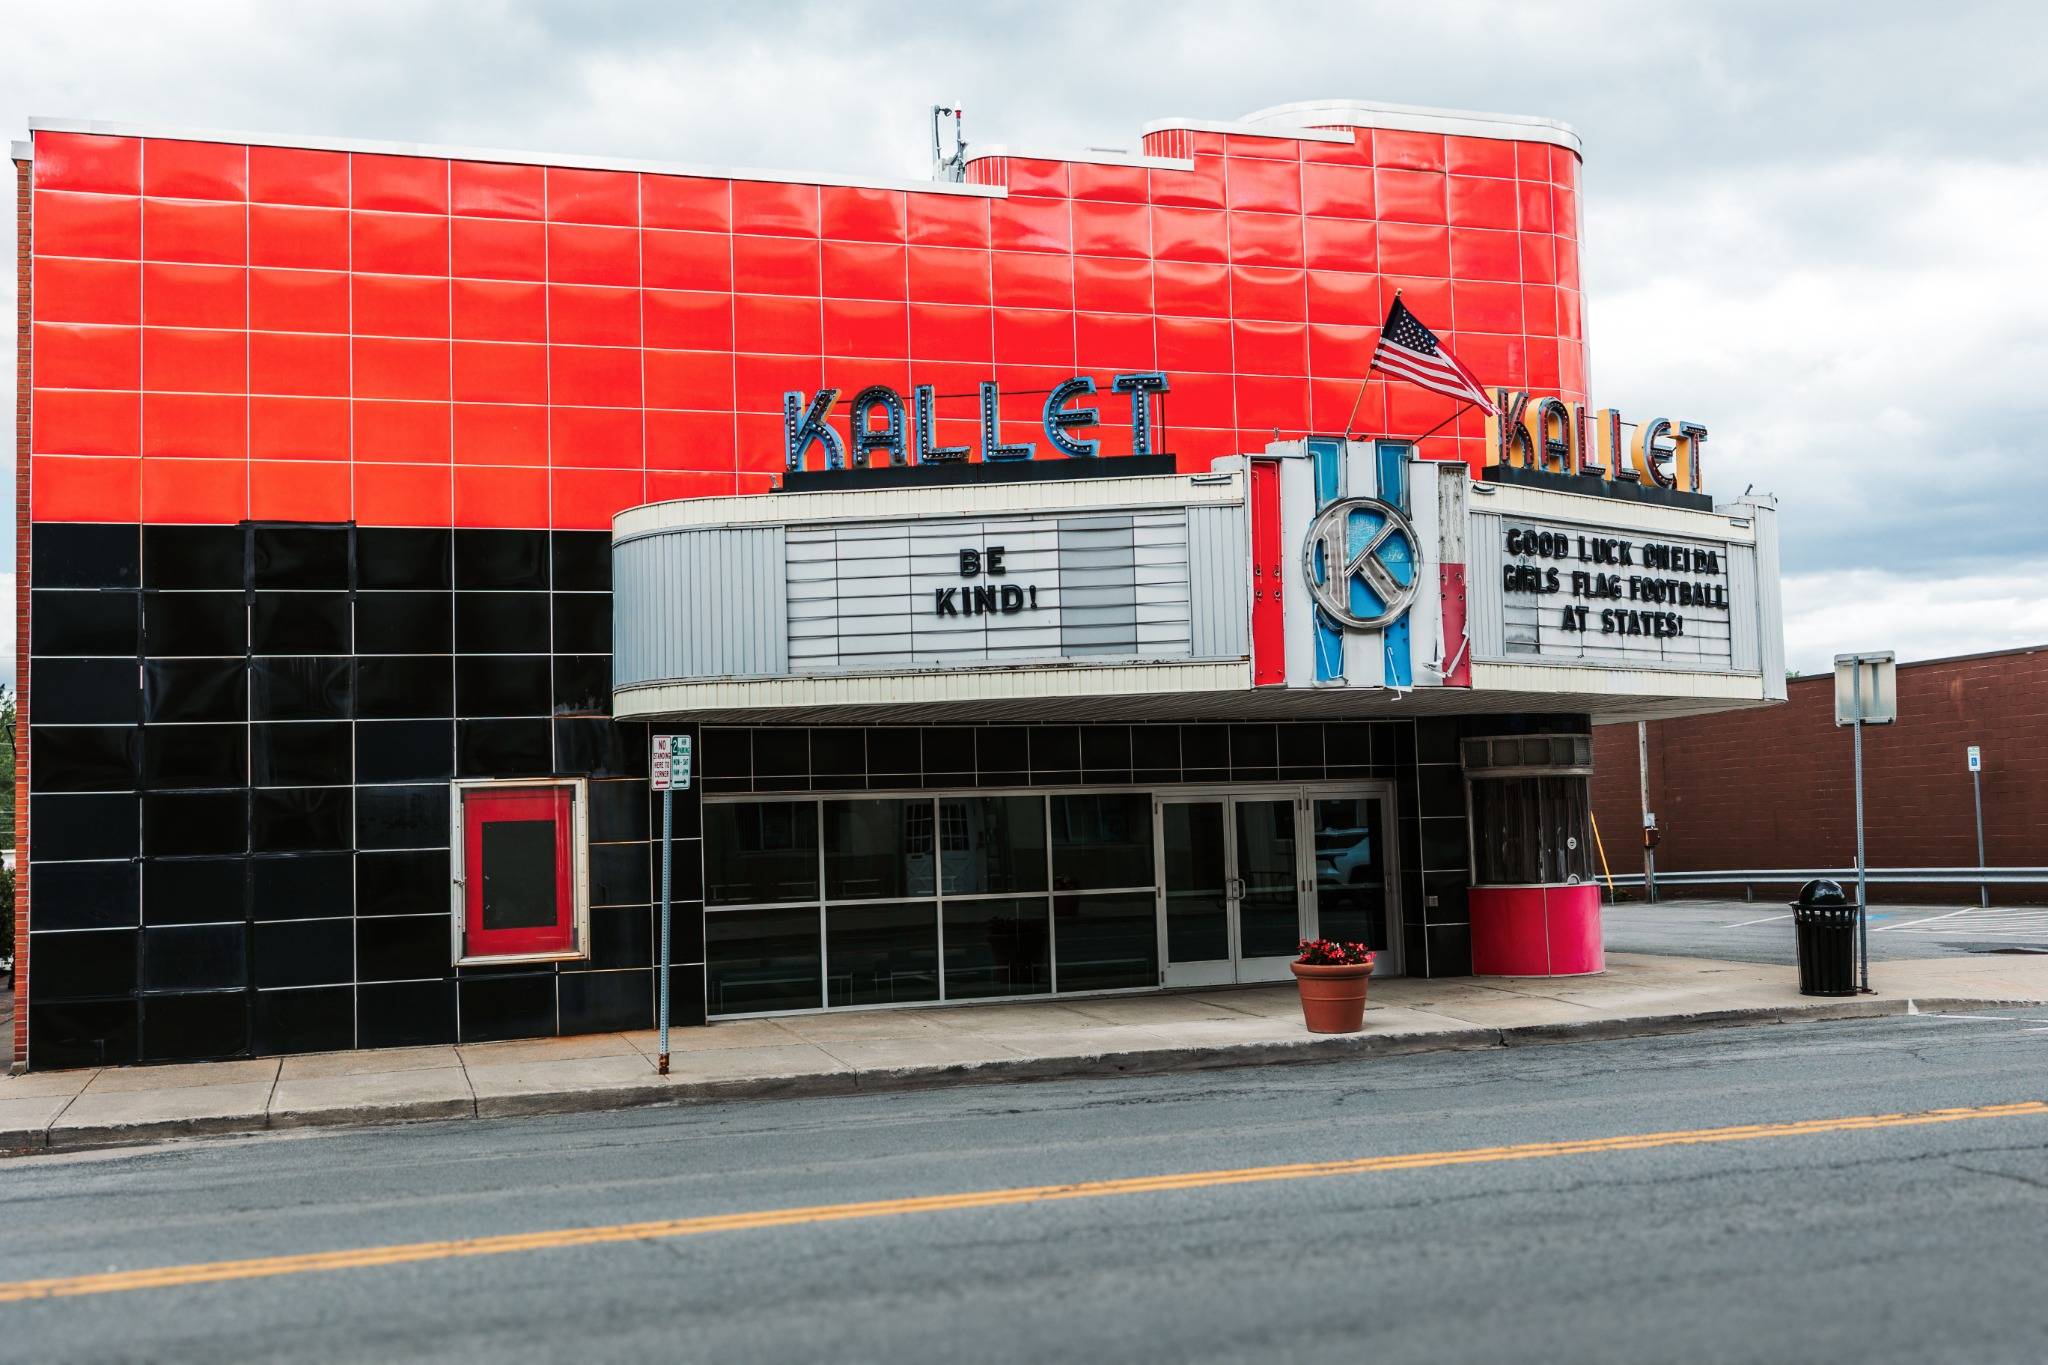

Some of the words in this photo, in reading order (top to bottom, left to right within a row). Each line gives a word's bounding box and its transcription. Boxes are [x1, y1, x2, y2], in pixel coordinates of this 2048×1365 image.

[783, 372, 1170, 471] KALLET
[1486, 387, 1708, 494] KALLET
[959, 546, 1007, 578] BE
[1318, 508, 1408, 618] K
[1507, 528, 1569, 559] GOOD
[1578, 535, 1633, 566] LUCK
[1643, 543, 1720, 575] ONEIDA
[935, 584, 1038, 618] KIND!
[1503, 564, 1560, 594] GIRLS
[1572, 570, 1622, 600] FLAG
[1630, 575, 1729, 609] FOOTBALL
[1562, 604, 1590, 632] AT
[1602, 608, 1684, 638] STATES!
[658, 740, 666, 750] NO
